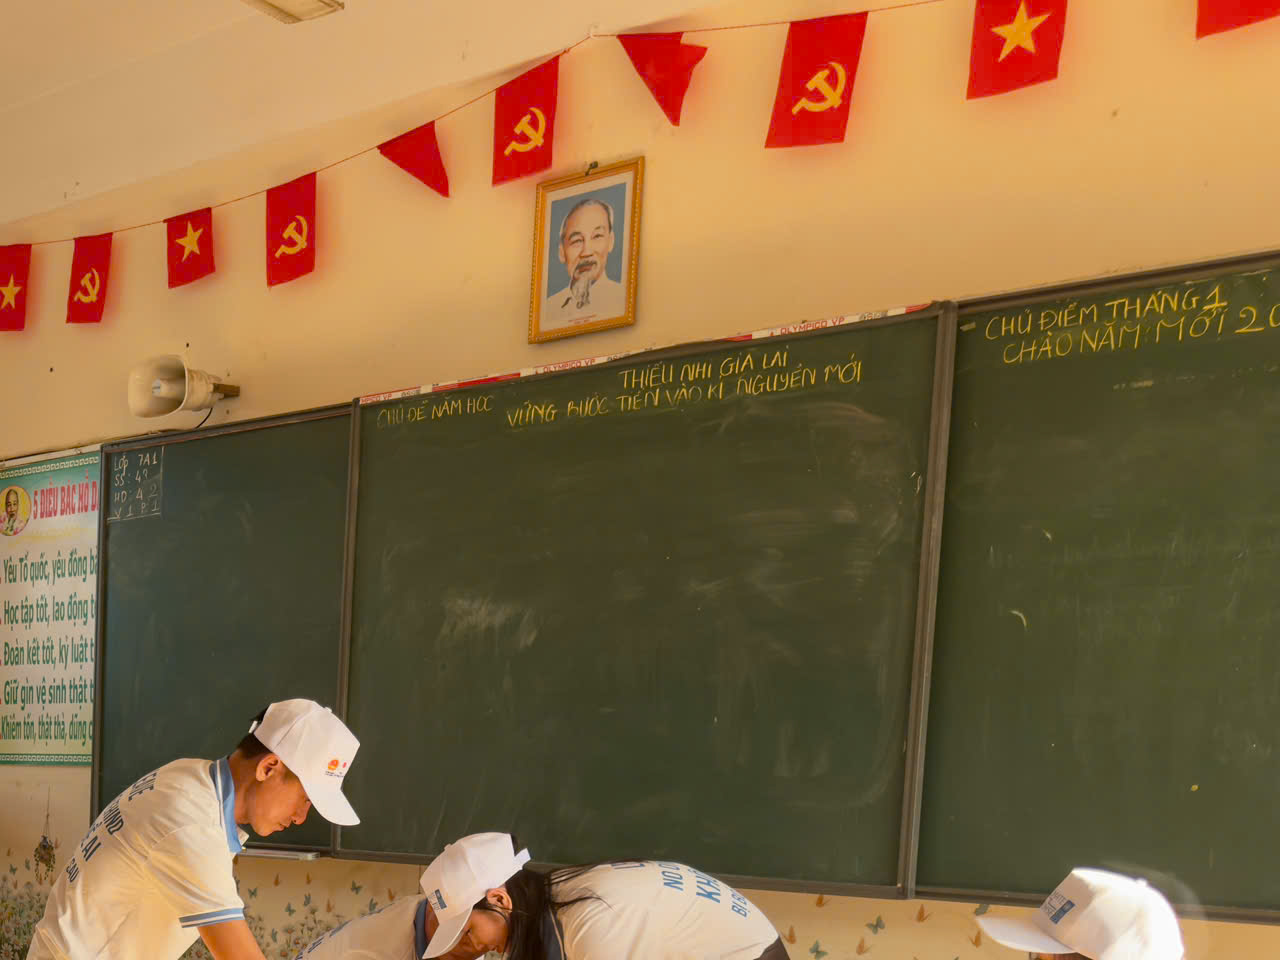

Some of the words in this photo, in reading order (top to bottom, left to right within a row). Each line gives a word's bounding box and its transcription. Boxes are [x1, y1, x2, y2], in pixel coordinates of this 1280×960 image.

[1104, 288, 1201, 321] THÁNG
[1003, 331, 1073, 364] CHÀO
[1080, 321, 1140, 352] NĂM
[680, 360, 713, 382] NHI
[720, 352, 754, 377] GIA
[33, 489, 39, 520] 5
[3, 555, 18, 584] Yêu
[52, 549, 66, 586] yêu
[3, 600, 19, 632] Học
[21, 595, 34, 631] tập
[52, 595, 65, 622] lao
[3, 638, 25, 667] Đoàn
[26, 637, 41, 665] kết
[71, 634, 88, 671] luật
[48, 677, 67, 705] sinh
